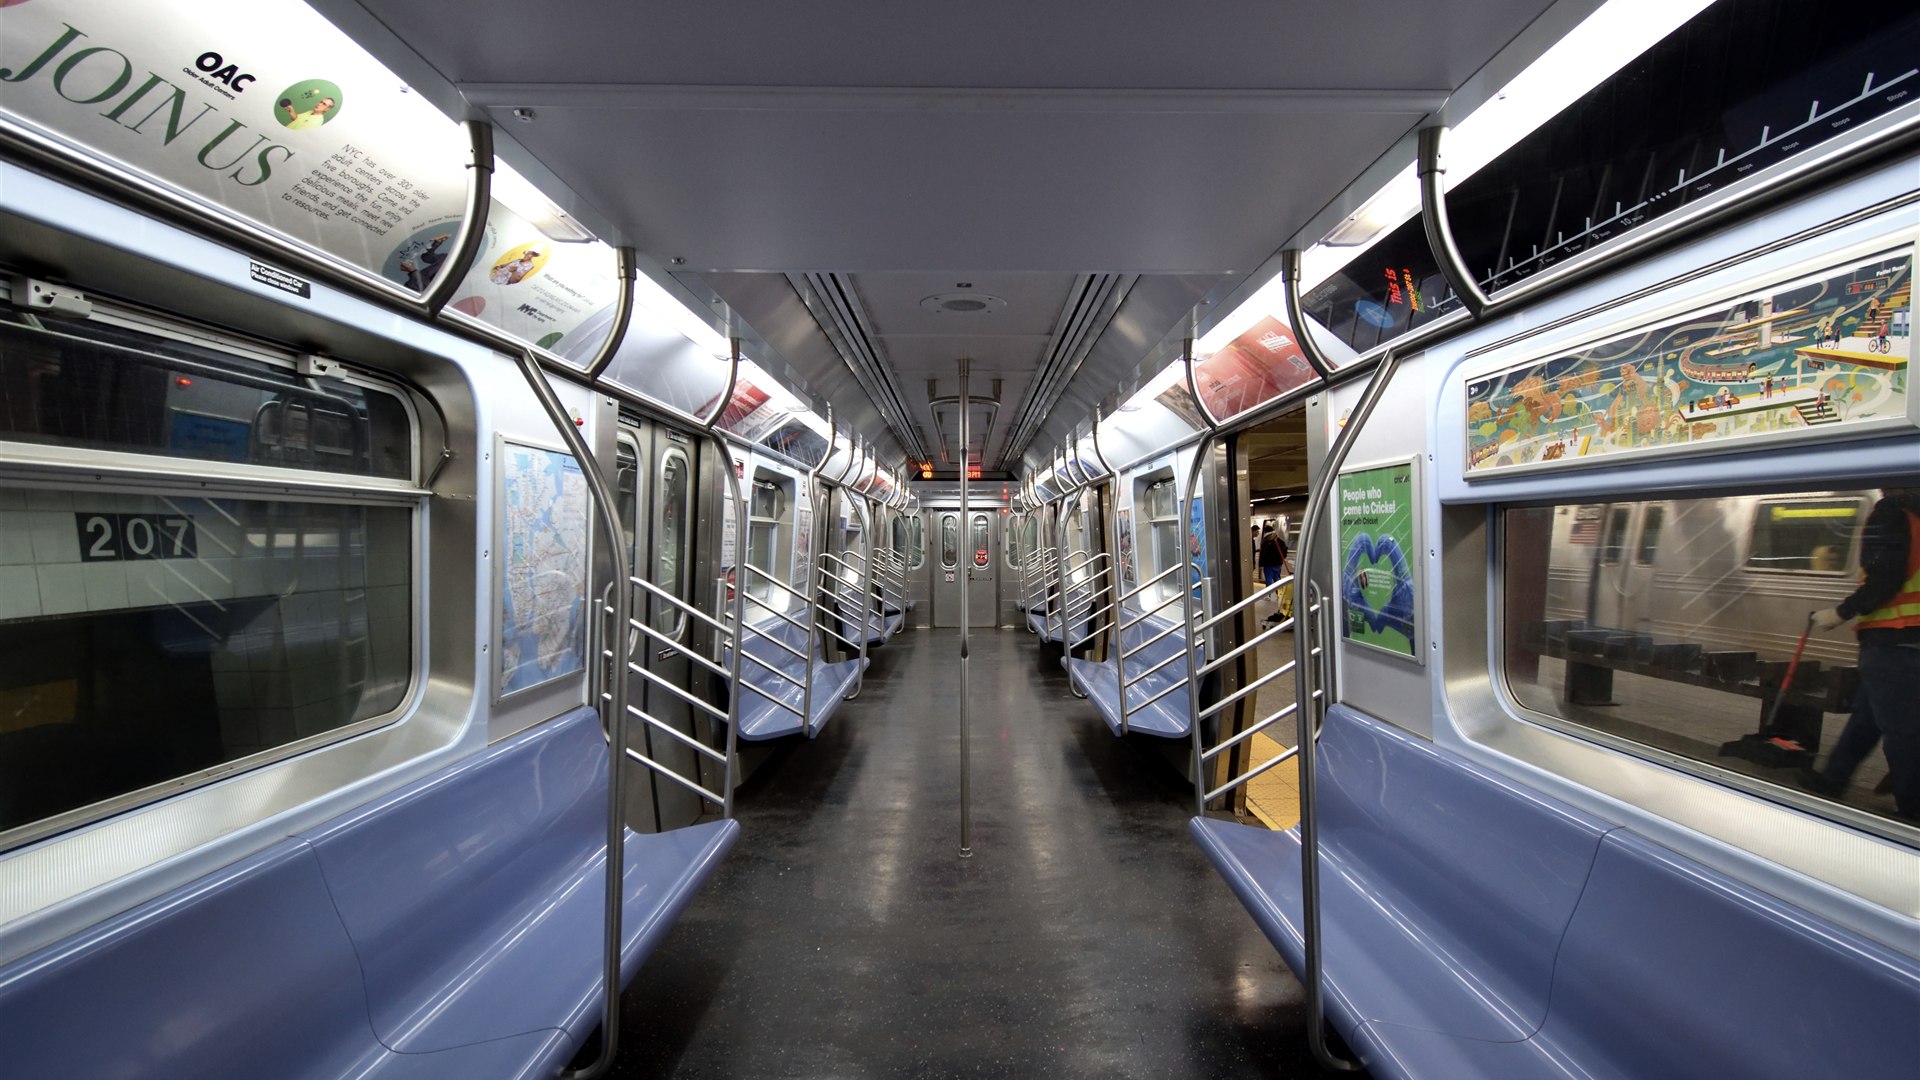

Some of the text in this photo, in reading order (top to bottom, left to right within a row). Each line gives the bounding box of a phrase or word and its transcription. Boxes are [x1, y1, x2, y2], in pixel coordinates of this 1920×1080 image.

[182, 67, 199, 79] Older
[198, 77, 215, 89] Adult
[195, 52, 257, 93] OAC
[0, 22, 296, 187] JOIN US
[1886, 89, 1909, 103] Stops
[1831, 116, 1851, 129] Stops
[1782, 140, 1799, 152] Stops
[331, 152, 421, 208] adult centers across the
[342, 143, 430, 201] NYC has over 300 older
[281, 191, 292, 201] to
[311, 168, 353, 195] experience
[355, 192, 369, 203] the
[385, 210, 403, 223] enjoy
[321, 159, 337, 172] five
[377, 192, 398, 208] Come
[399, 205, 415, 215] and
[301, 176, 336, 198] delicious
[360, 208, 381, 222] meet
[380, 218, 396, 229] new
[322, 199, 340, 211] and
[335, 208, 352, 219] get
[351, 216, 389, 236] connected
[1620, 217, 1632, 228] 10
[251, 263, 303, 288] Air Conditioned Car
[251, 270, 267, 282] Please
[267, 277, 280, 287] close
[1384, 267, 1403, 305] This is
[517, 303, 538, 316] NYC
[1343, 486, 1382, 503] People who
[1343, 499, 1396, 516] come to Cricket
[86, 516, 189, 557] 207
